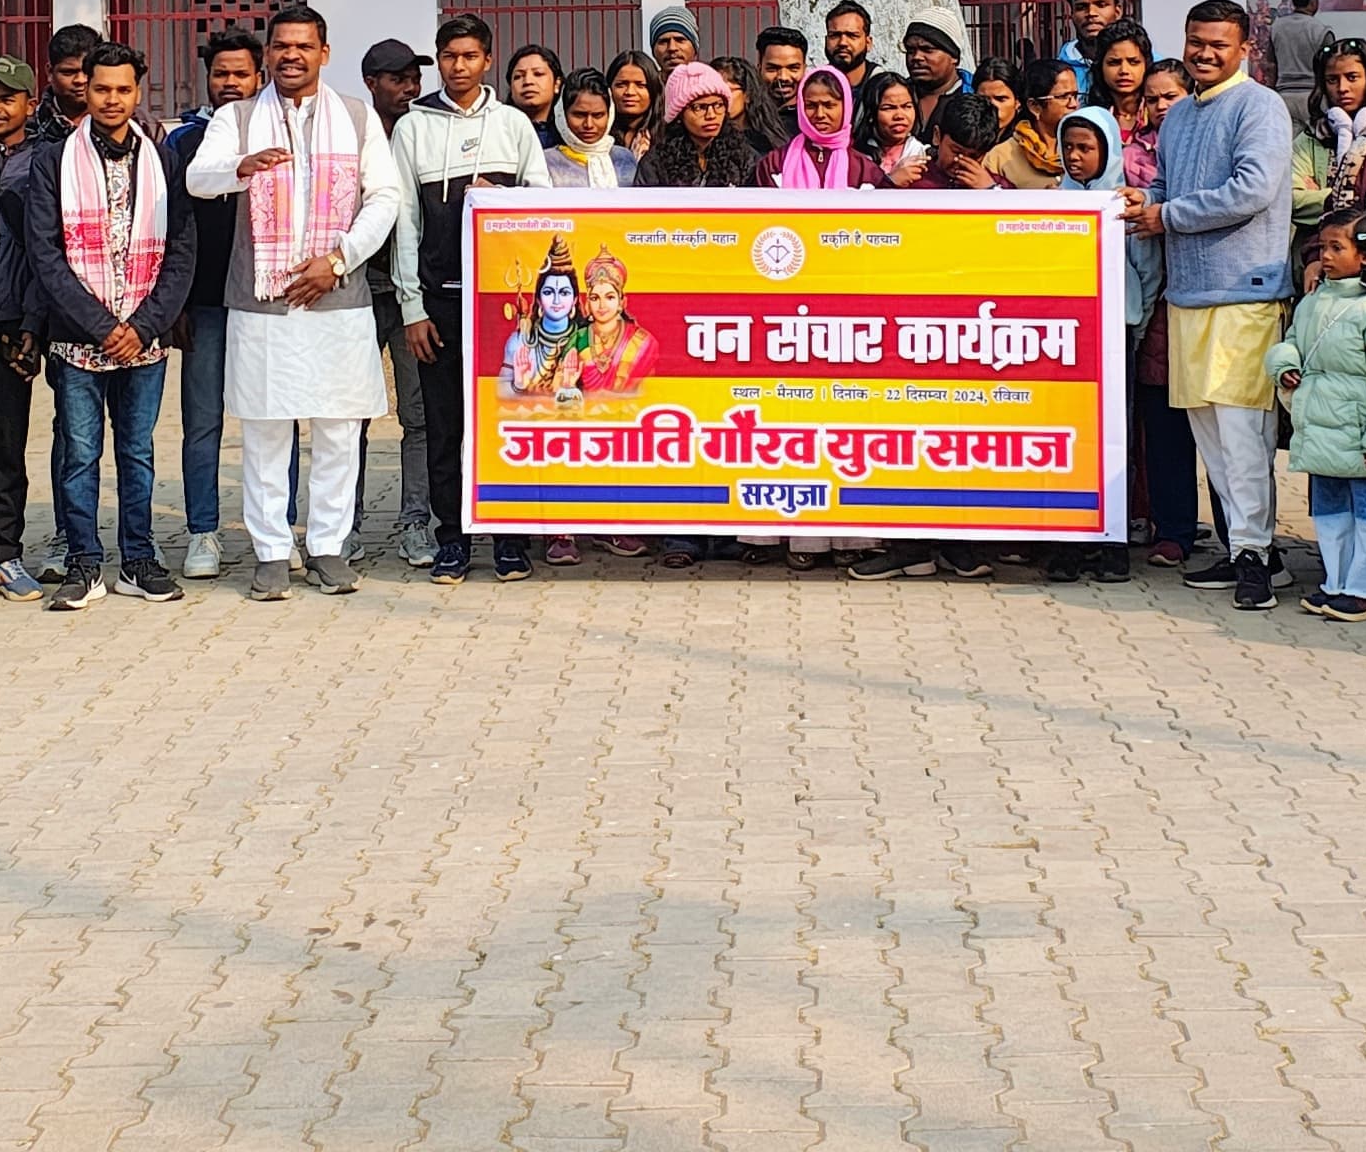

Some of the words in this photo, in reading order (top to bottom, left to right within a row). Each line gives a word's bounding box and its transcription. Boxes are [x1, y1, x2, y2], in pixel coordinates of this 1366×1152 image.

[492, 220, 516, 230] महादेव
[518, 219, 539, 229] पार्वती
[1006, 221, 1030, 231] महादेव
[1031, 221, 1054, 231] पार्वती
[627, 230, 667, 244] जनजाति
[671, 230, 707, 246] संस्कृति
[712, 233, 737, 244] महान
[821, 230, 850, 248] प्रकृति
[854, 230, 861, 245] है
[866, 234, 900, 245] पहचान
[684, 314, 754, 363] वन
[763, 304, 887, 364] संचार
[894, 301, 1080, 372] कार्यक्रम
[732, 387, 760, 399] स्थल
[777, 384, 814, 399] मैनपाठ
[833, 384, 868, 399] दिनांक
[886, 389, 901, 401] 22
[954, 390, 988, 404] 2024,
[993, 386, 1030, 402] रविवार
[503, 409, 694, 463] जनजाति
[701, 409, 818, 465] गौरव
[825, 429, 917, 477] युवा
[923, 430, 1072, 468] समाज
[741, 483, 828, 514] सरगुजा
